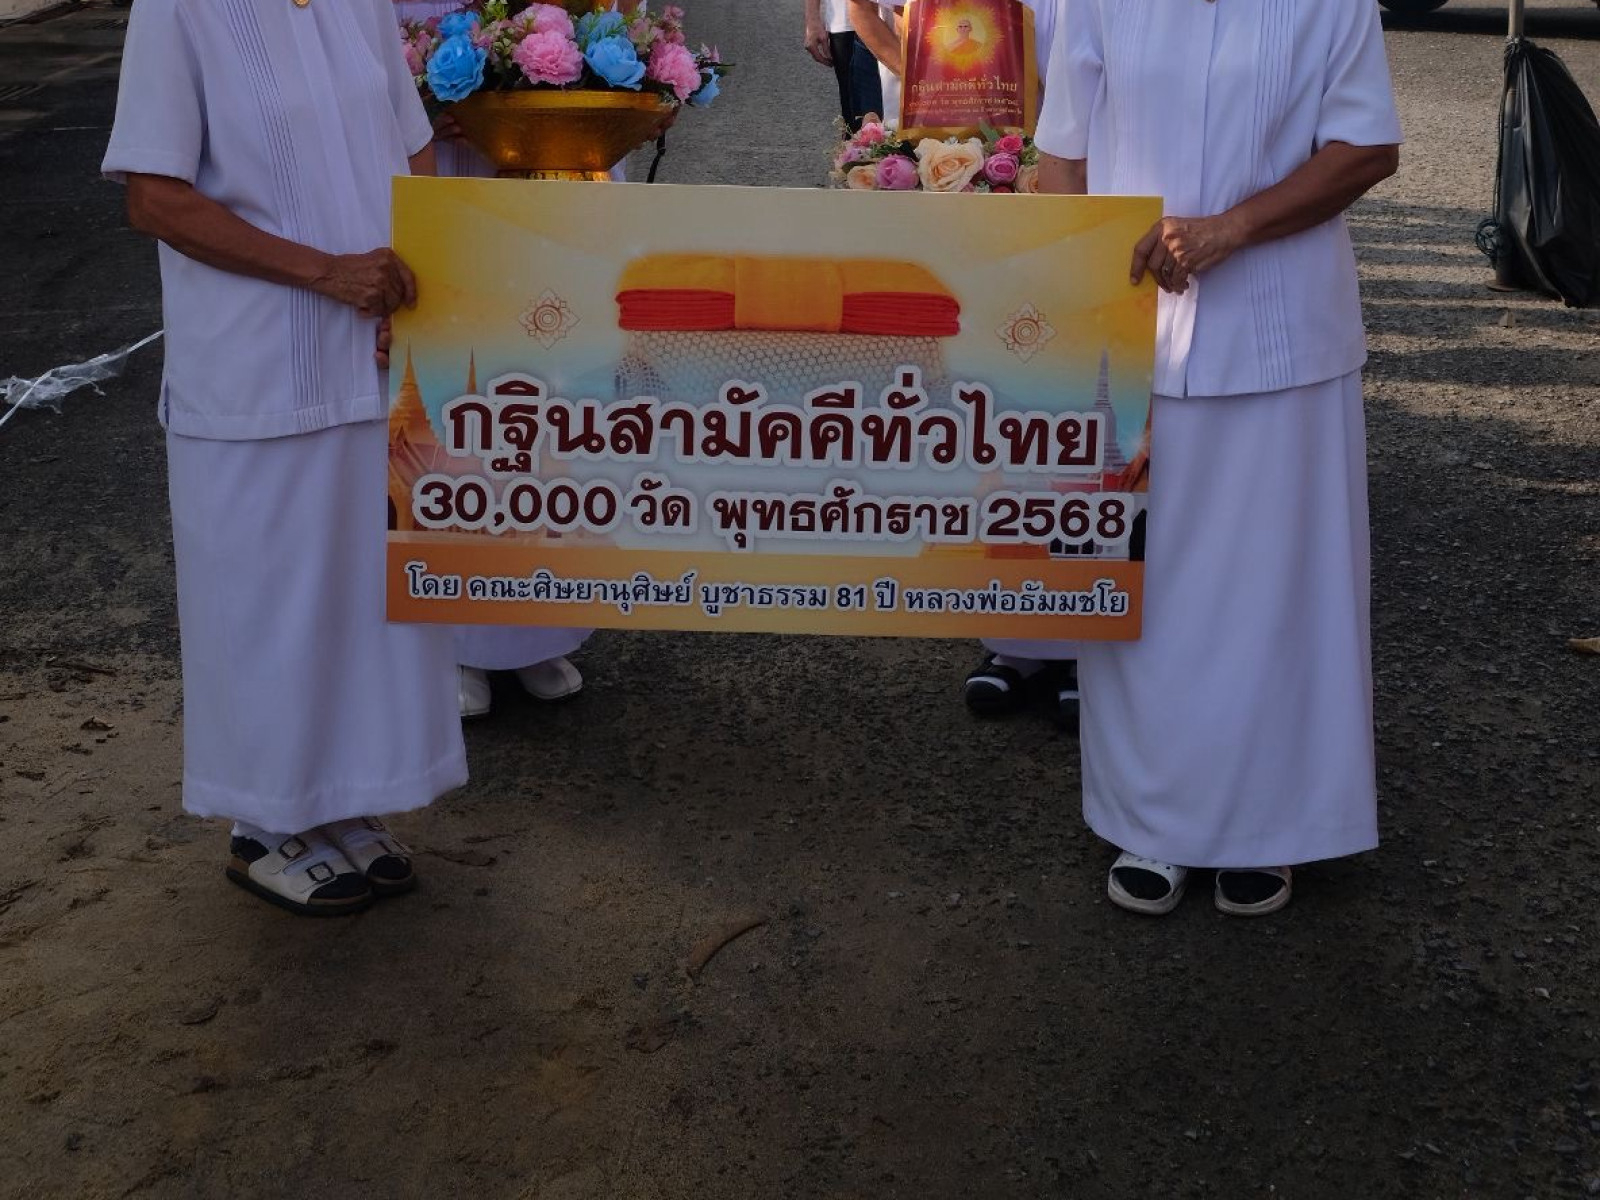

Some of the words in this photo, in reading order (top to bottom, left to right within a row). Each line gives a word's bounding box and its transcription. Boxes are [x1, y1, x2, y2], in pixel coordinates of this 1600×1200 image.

[449, 372, 1098, 472] กฐินสามัคคีทั่วไทย
[419, 480, 617, 527] 30,000
[630, 479, 691, 527] วัด
[712, 486, 969, 548] พุทธศักราช
[986, 498, 1126, 539] 2568
[407, 565, 459, 597] โดย
[469, 572, 694, 613] คณะศิษยานุศิษย์
[702, 584, 827, 614] บูชาธรรม
[837, 587, 865, 608] 81
[875, 581, 895, 608] ปี
[905, 582, 1126, 614] หลวงพ่อธัมมชโย
